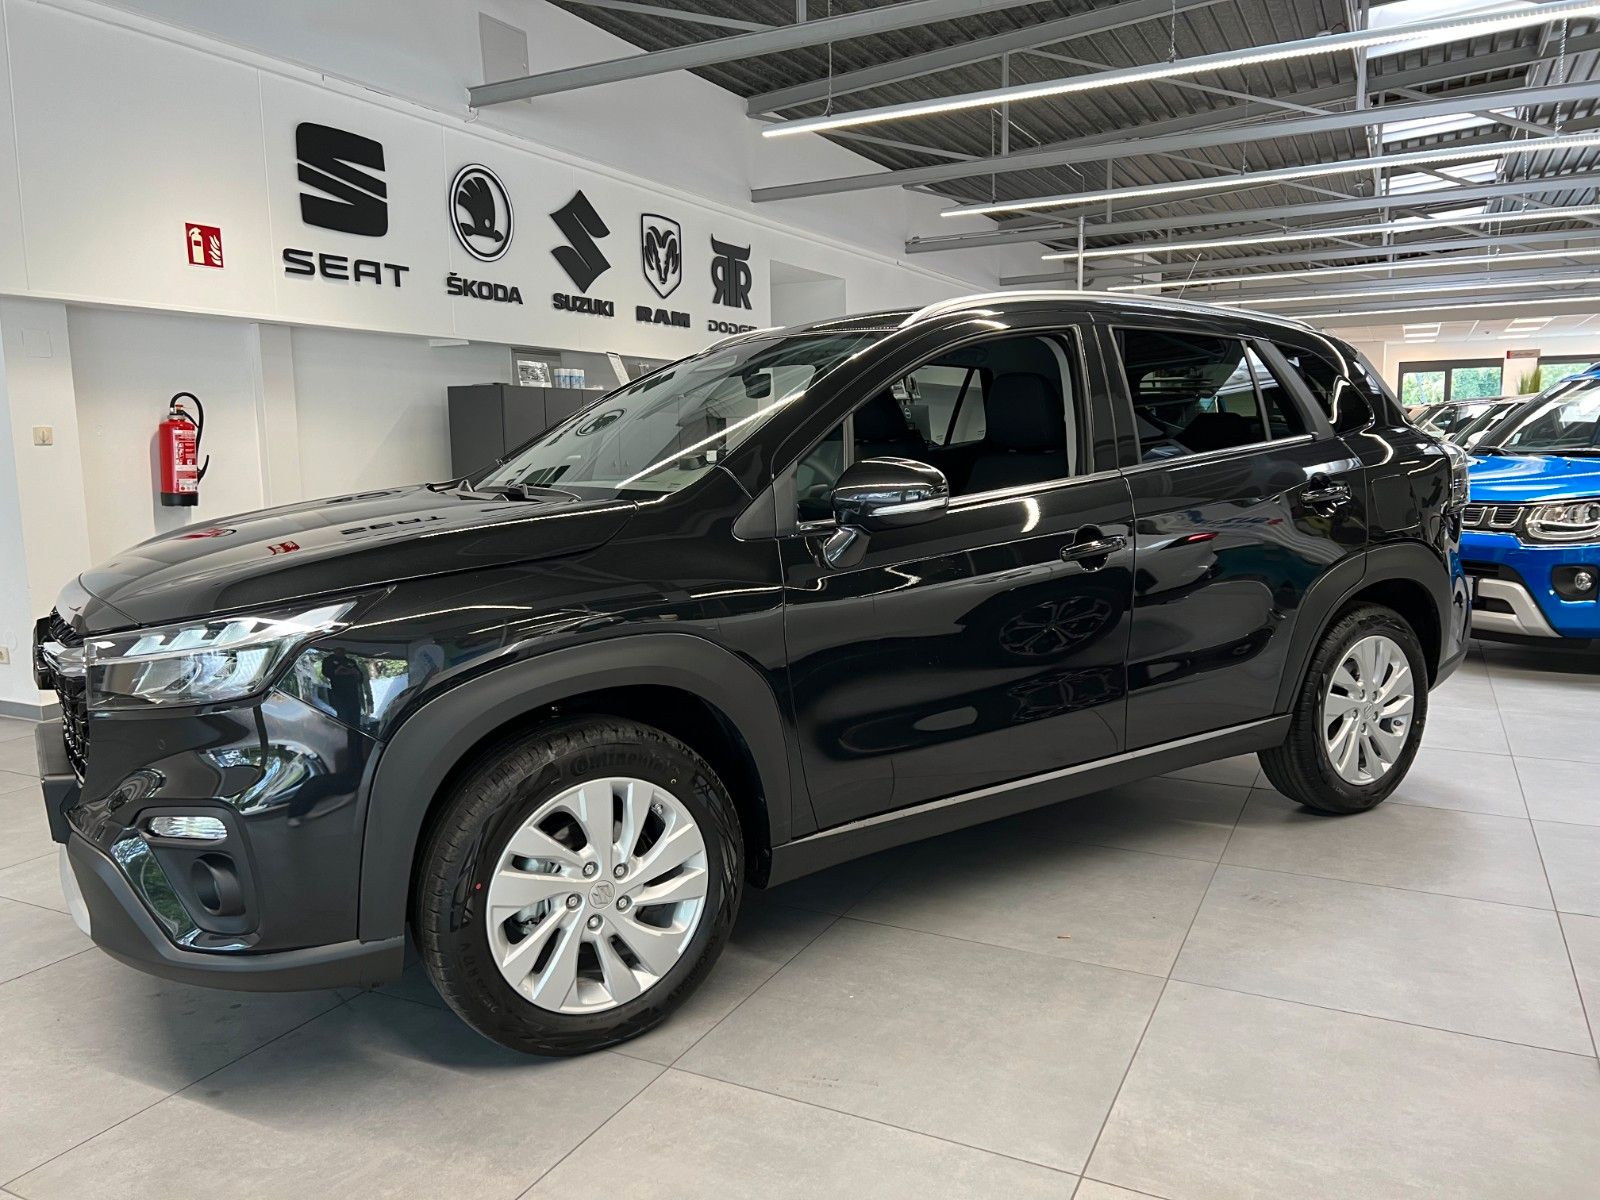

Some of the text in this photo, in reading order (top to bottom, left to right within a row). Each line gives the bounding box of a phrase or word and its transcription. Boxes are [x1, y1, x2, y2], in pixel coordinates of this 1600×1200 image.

[283, 247, 410, 288] SEAT
[446, 271, 523, 305] ŠKODA
[552, 292, 615, 317] SUZUKI
[635, 305, 691, 328] RAM
